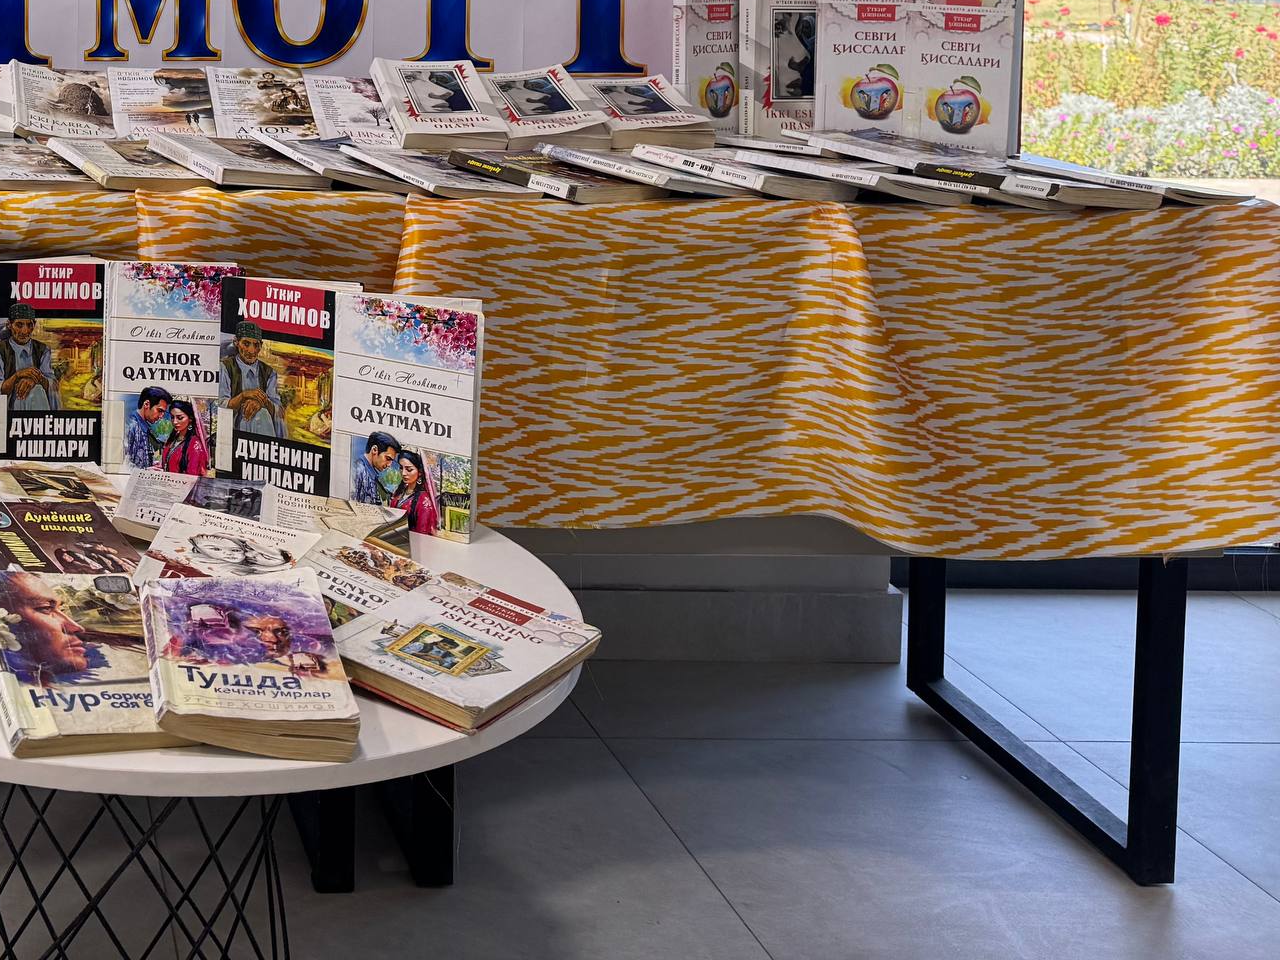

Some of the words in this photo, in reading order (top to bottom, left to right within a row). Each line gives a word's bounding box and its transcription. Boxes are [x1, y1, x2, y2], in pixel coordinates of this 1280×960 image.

[706, 31, 732, 41] СЕВГИ
[854, 30, 897, 41] СЕВГИ
[692, 43, 740, 57] ҚИССАЛАР
[941, 41, 981, 53] СЕВГИ
[920, 53, 1001, 68] ҚИССАЛАРИ
[765, 109, 790, 119] IKKI
[38, 265, 74, 279] ЎТКИР
[266, 284, 302, 303] ЎТКИР
[165, 326, 216, 341] Hoshimov
[143, 351, 201, 366] BAHOR
[122, 366, 220, 384] QAYTMAYDI
[394, 371, 448, 391] Hoshimov
[371, 392, 432, 417] BAHOR
[9, 414, 97, 438] ДУНЁНИНГ
[350, 406, 452, 439] QAYTMAYDI
[16, 440, 89, 458] ИШЛАРИ
[235, 438, 323, 472] ДУНЁНИНГ
[241, 462, 315, 494] ИШЛАРИ
[24, 511, 93, 524] Дунёнинг
[41, 523, 94, 534] ишлари
[317, 570, 390, 606] DUNYO
[328, 584, 378, 611] ISHL
[429, 595, 544, 645] DUNYONING
[440, 610, 515, 642] ISHLARI
[178, 665, 302, 690] Тушда
[28, 688, 102, 713] Нур
[100, 690, 153, 702] борки
[214, 686, 267, 697] кечган
[271, 688, 331, 700] умрлар
[111, 701, 140, 709] соя
